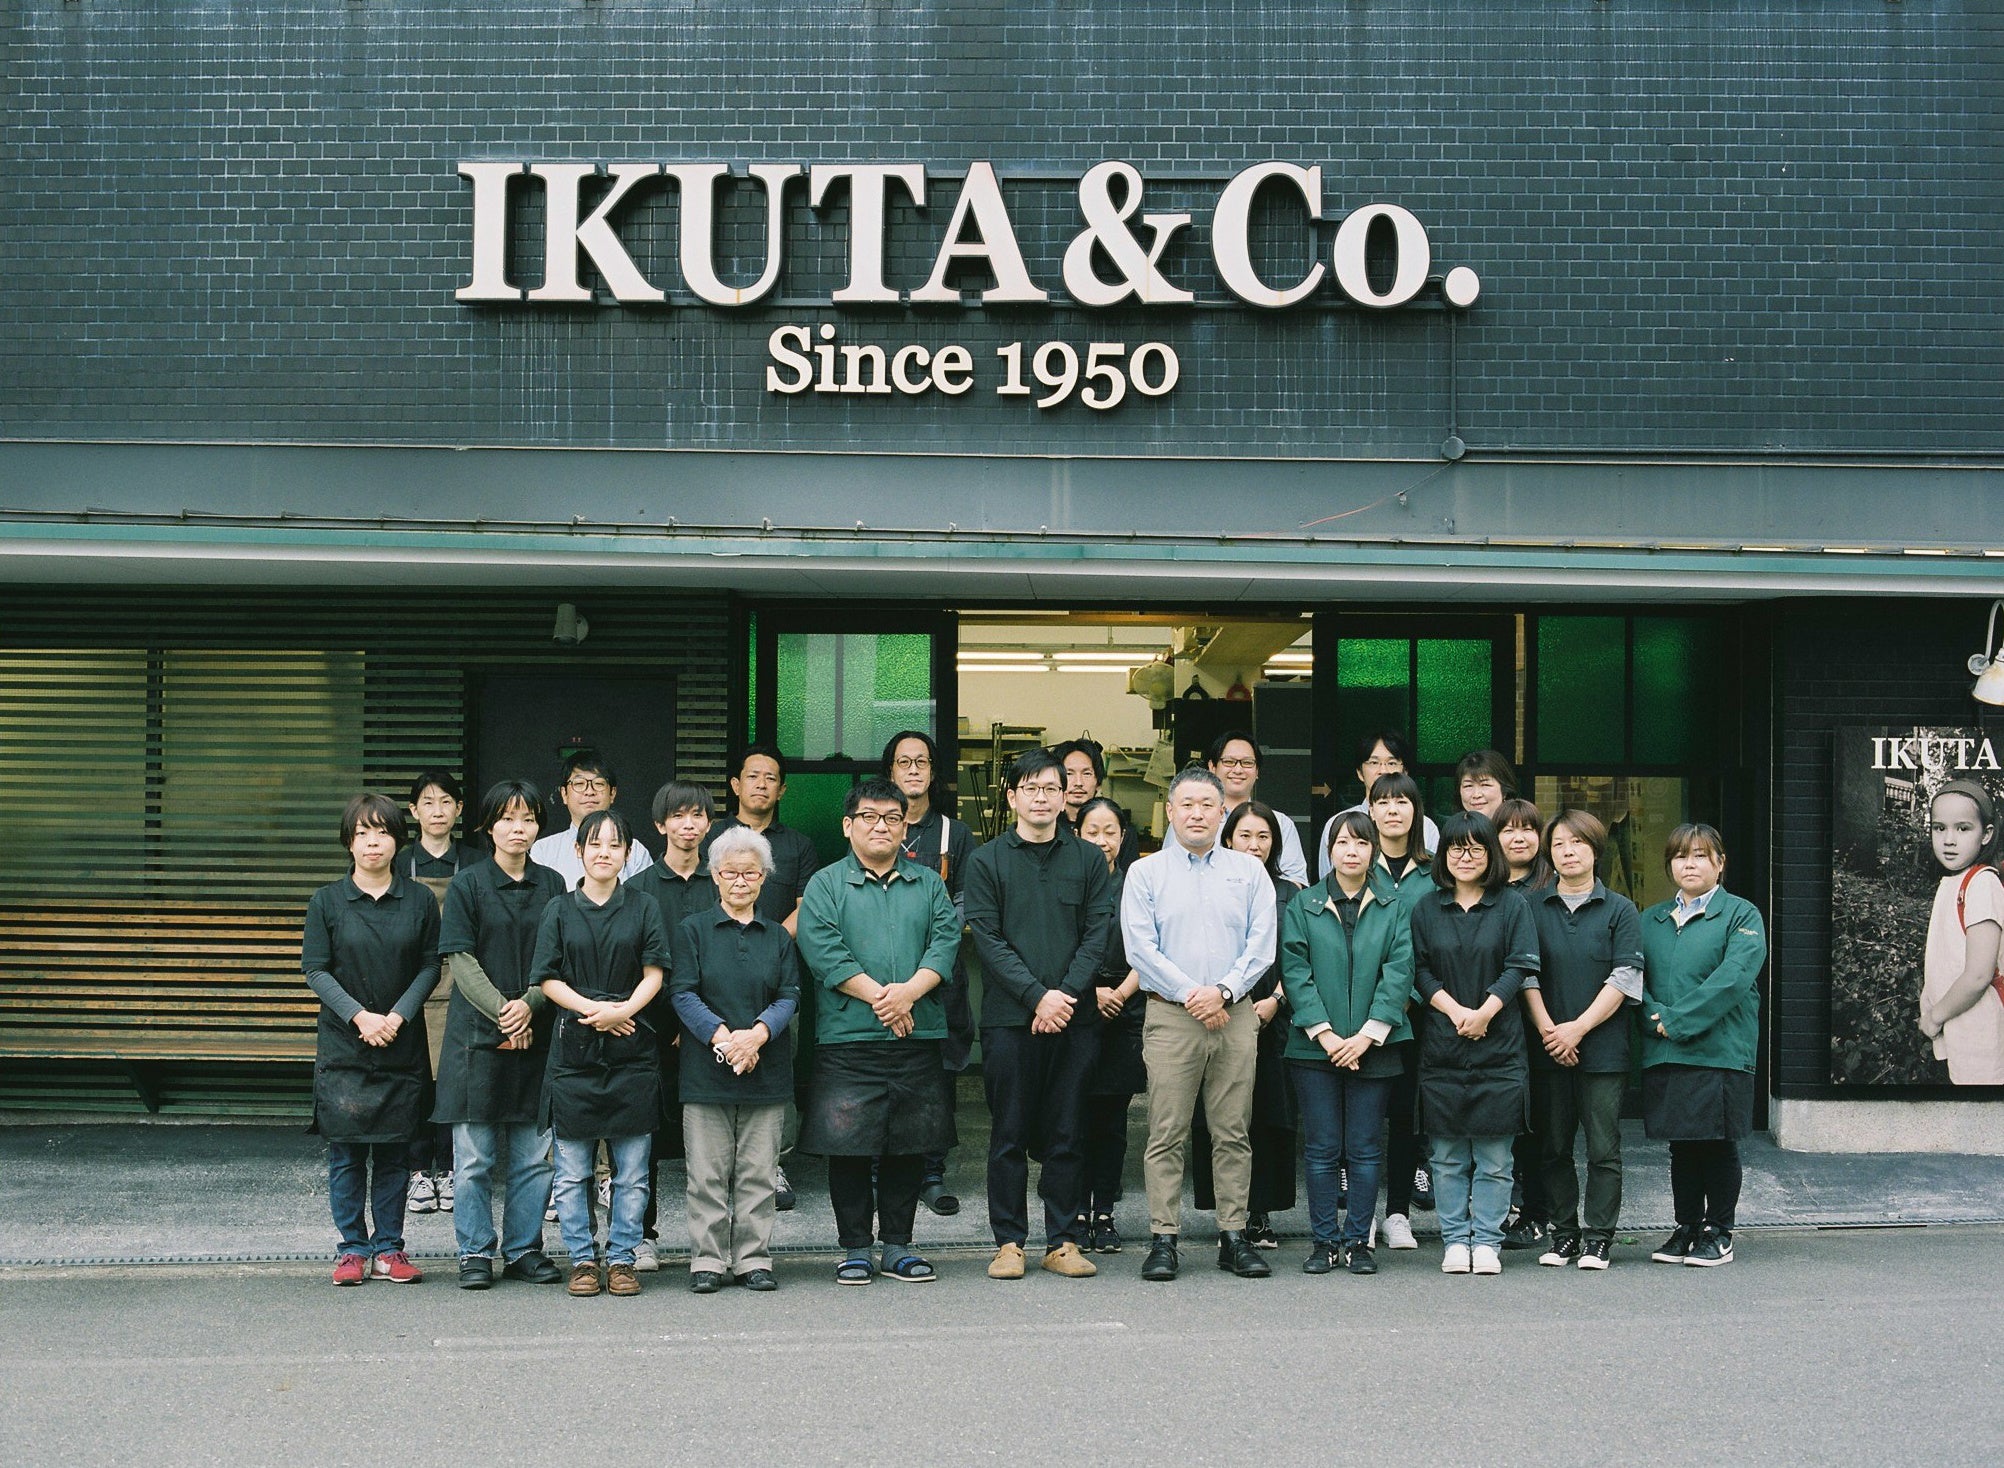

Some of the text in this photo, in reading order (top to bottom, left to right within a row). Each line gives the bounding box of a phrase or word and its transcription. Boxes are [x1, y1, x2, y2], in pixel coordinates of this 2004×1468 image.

[766, 323, 1179, 410] Since 1950
[1871, 737, 2002, 770] IKUTA
